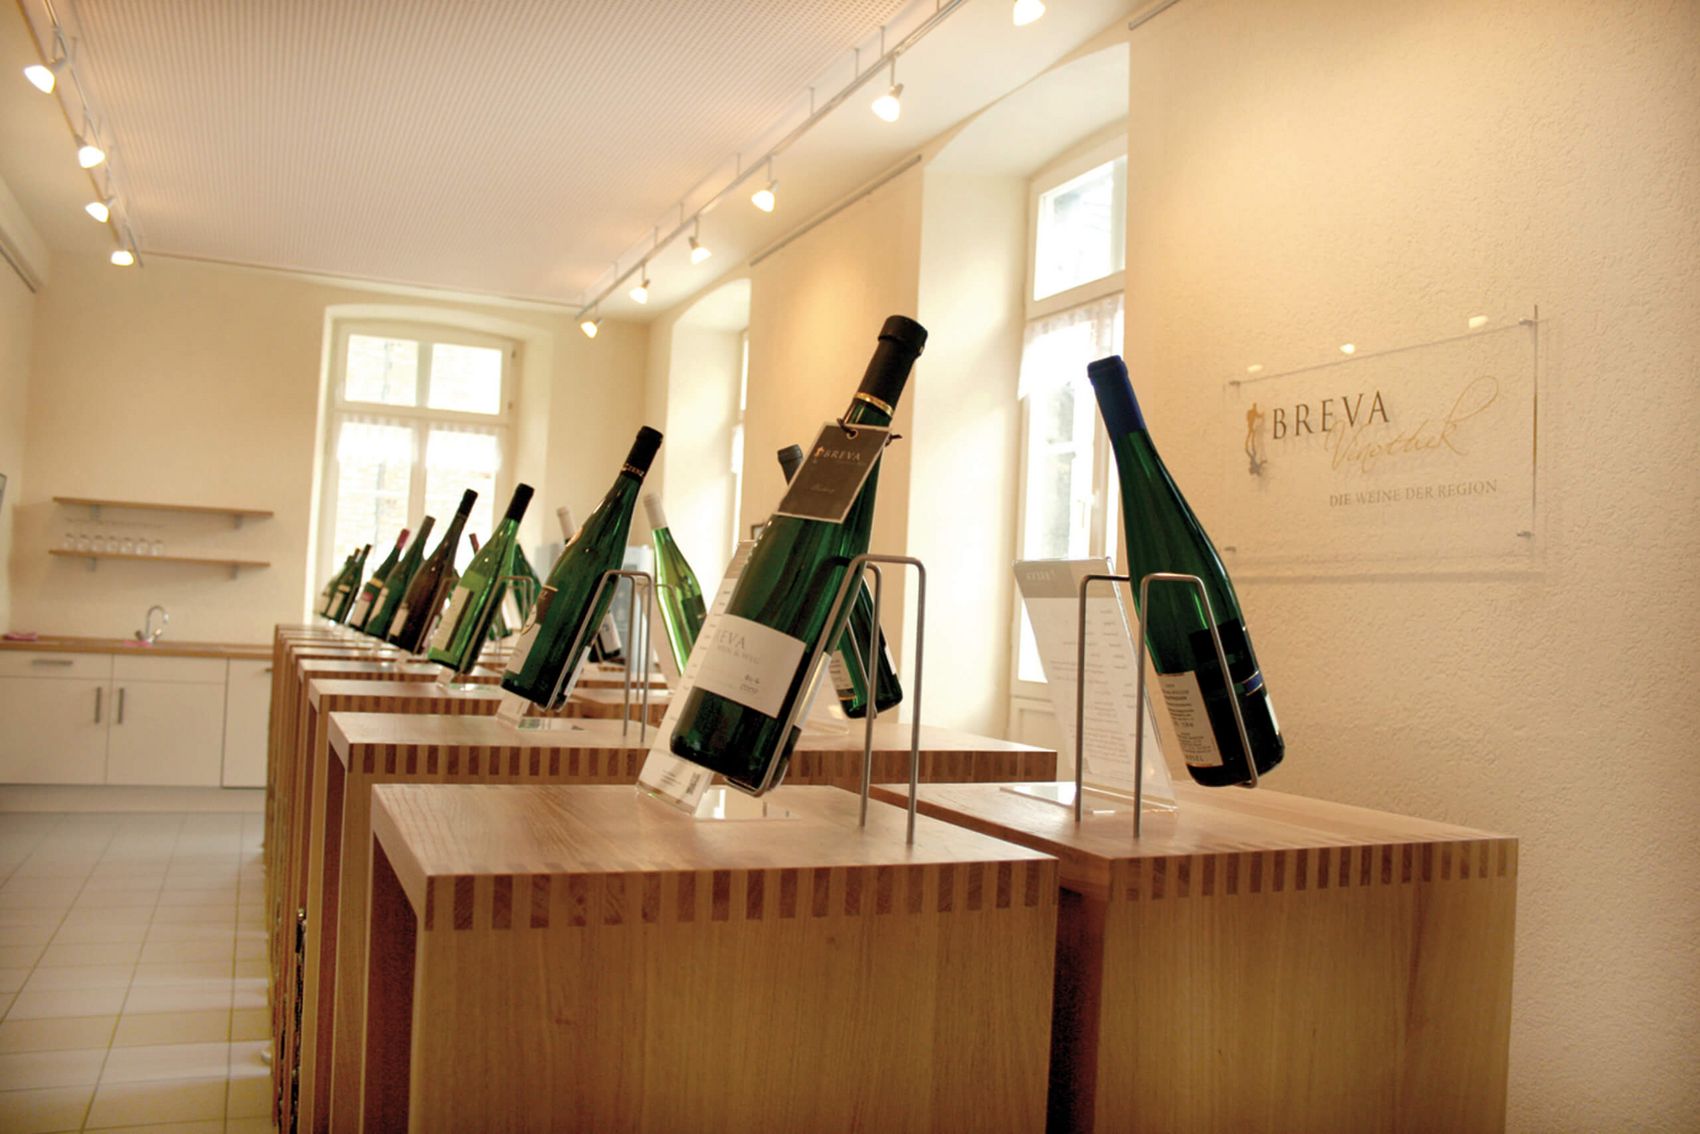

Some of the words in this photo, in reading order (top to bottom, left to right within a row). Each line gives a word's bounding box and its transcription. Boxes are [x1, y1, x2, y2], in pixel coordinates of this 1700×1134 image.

[1272, 389, 1391, 440] BREVA
[1324, 375, 1499, 473] Vinothek
[1329, 492, 1352, 508] DIE
[1355, 487, 1402, 505] WEINE
[1405, 485, 1434, 501] DER
[1438, 479, 1498, 499] REGION
